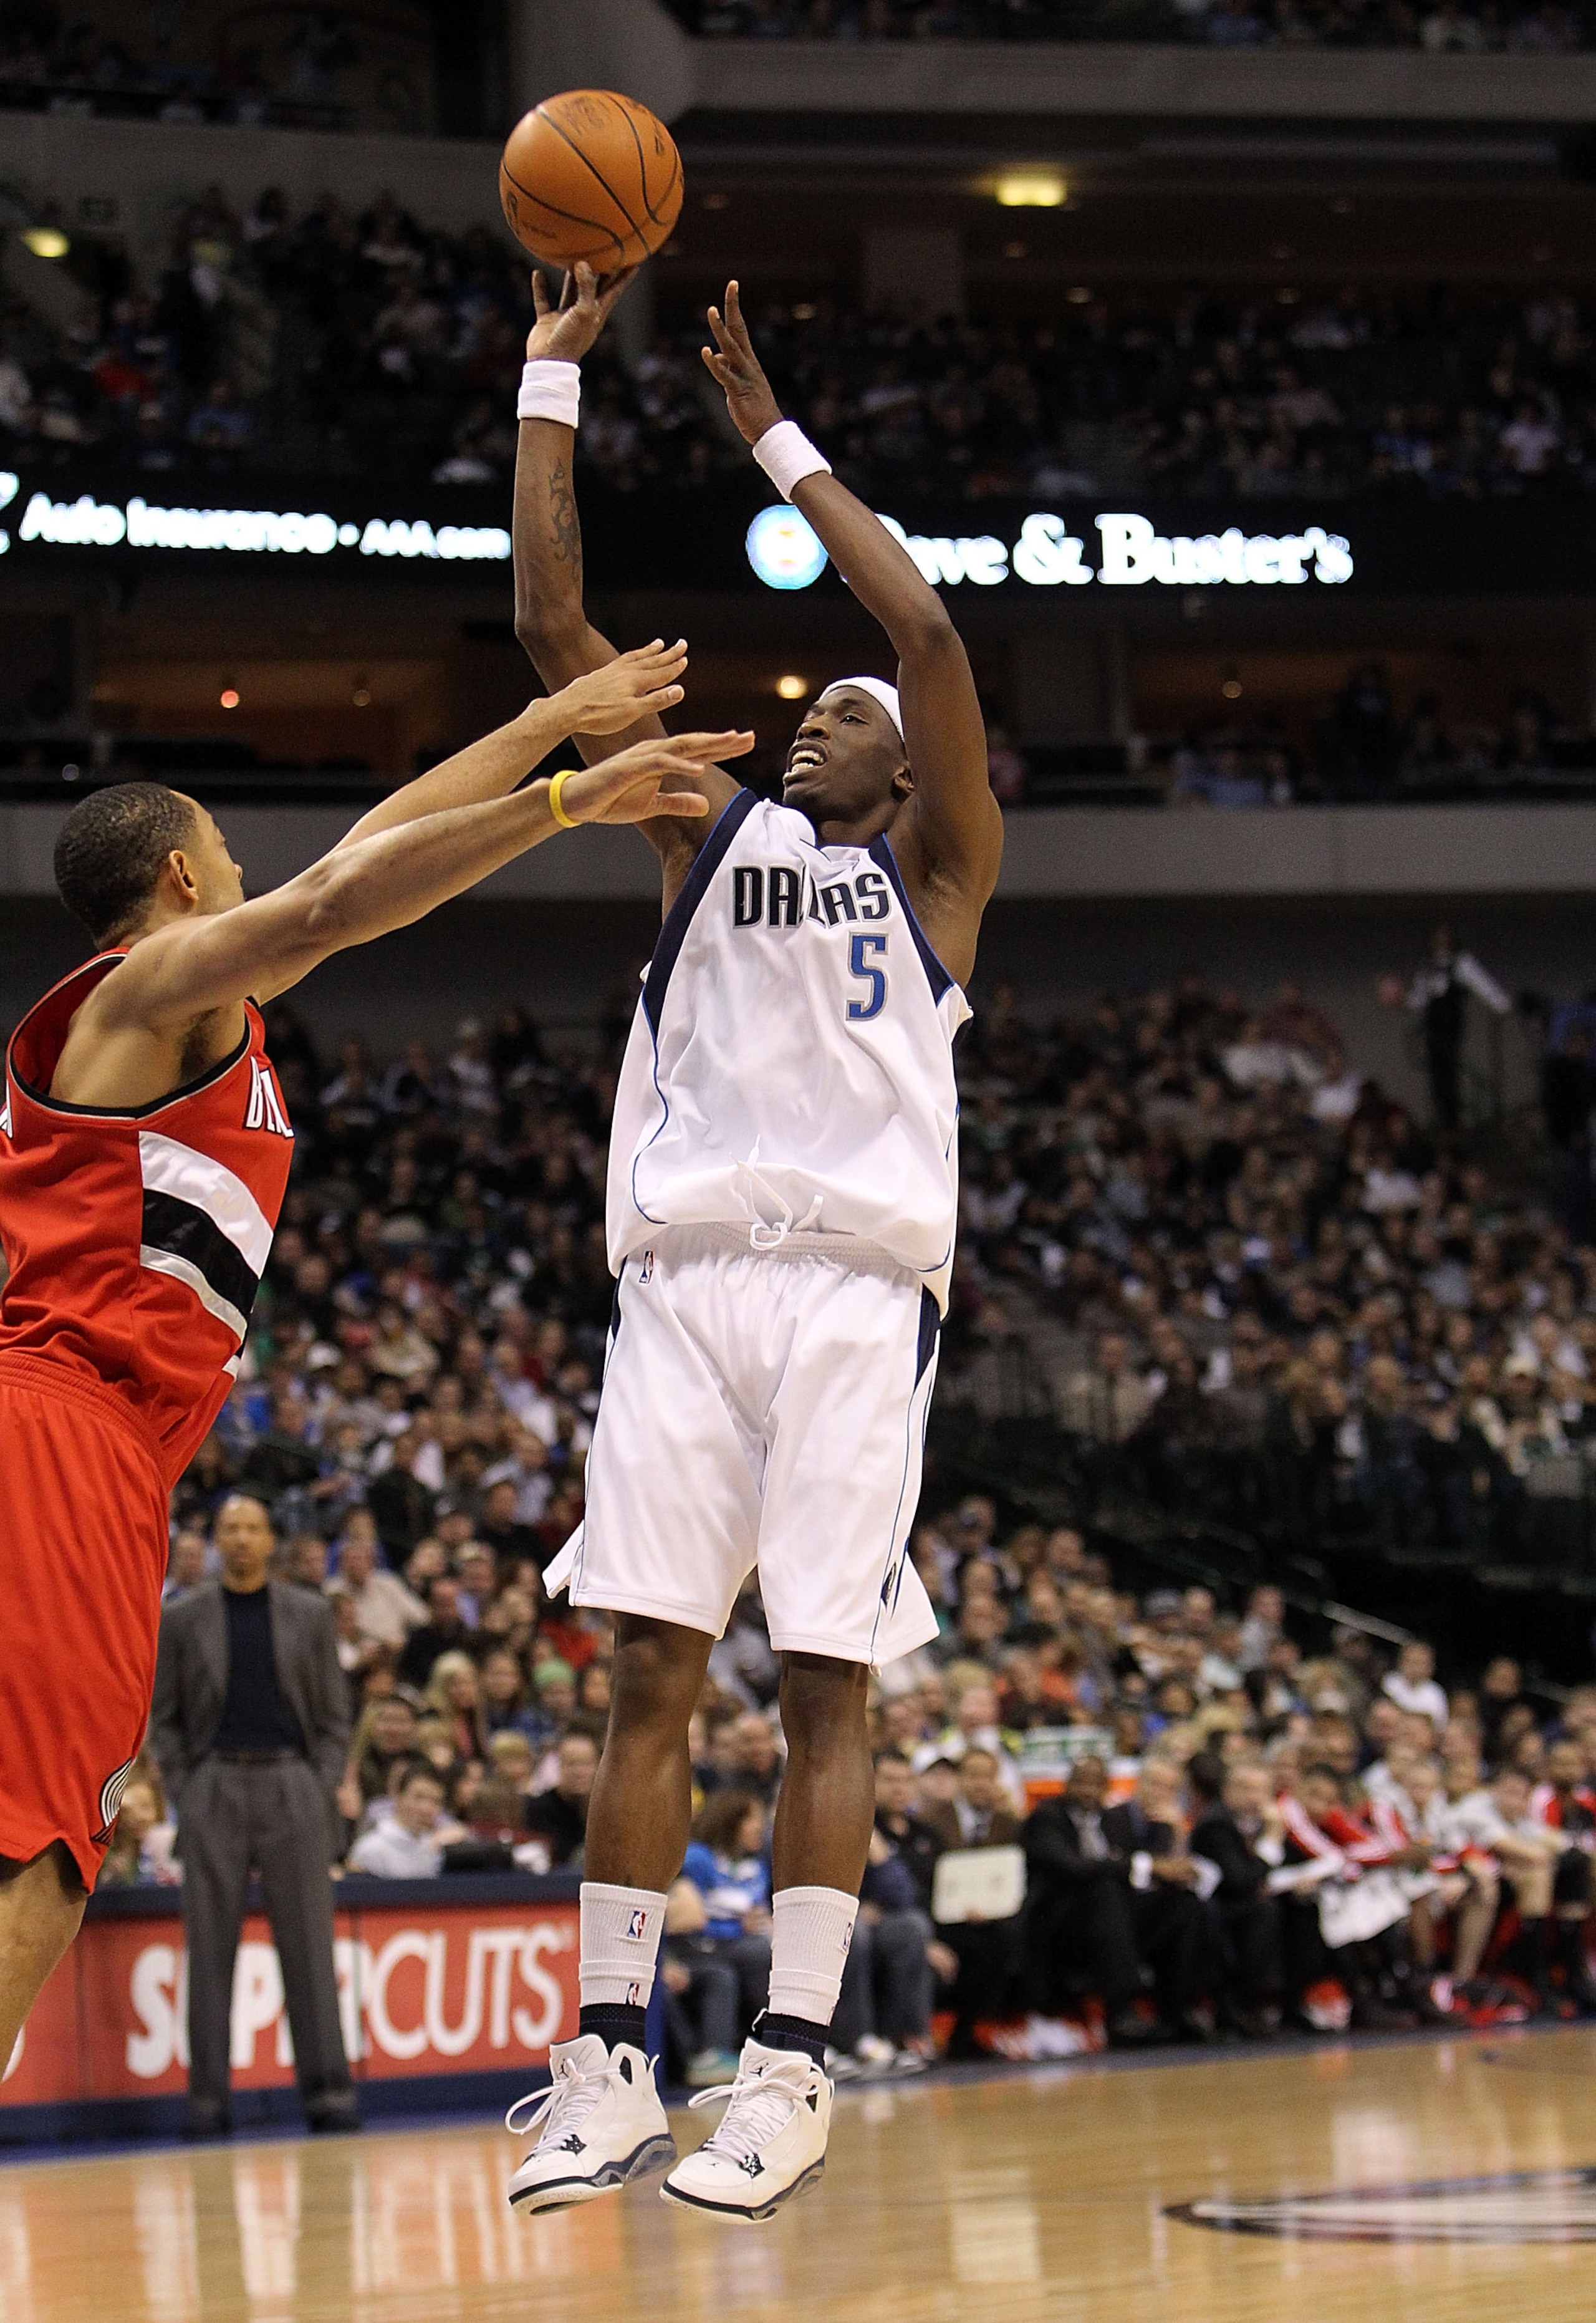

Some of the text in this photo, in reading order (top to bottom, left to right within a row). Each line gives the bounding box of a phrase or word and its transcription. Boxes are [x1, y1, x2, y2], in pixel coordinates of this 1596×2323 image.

[1013, 513, 1094, 585] &
[1095, 513, 1353, 585] Buster's
[845, 932, 889, 1021] 5
